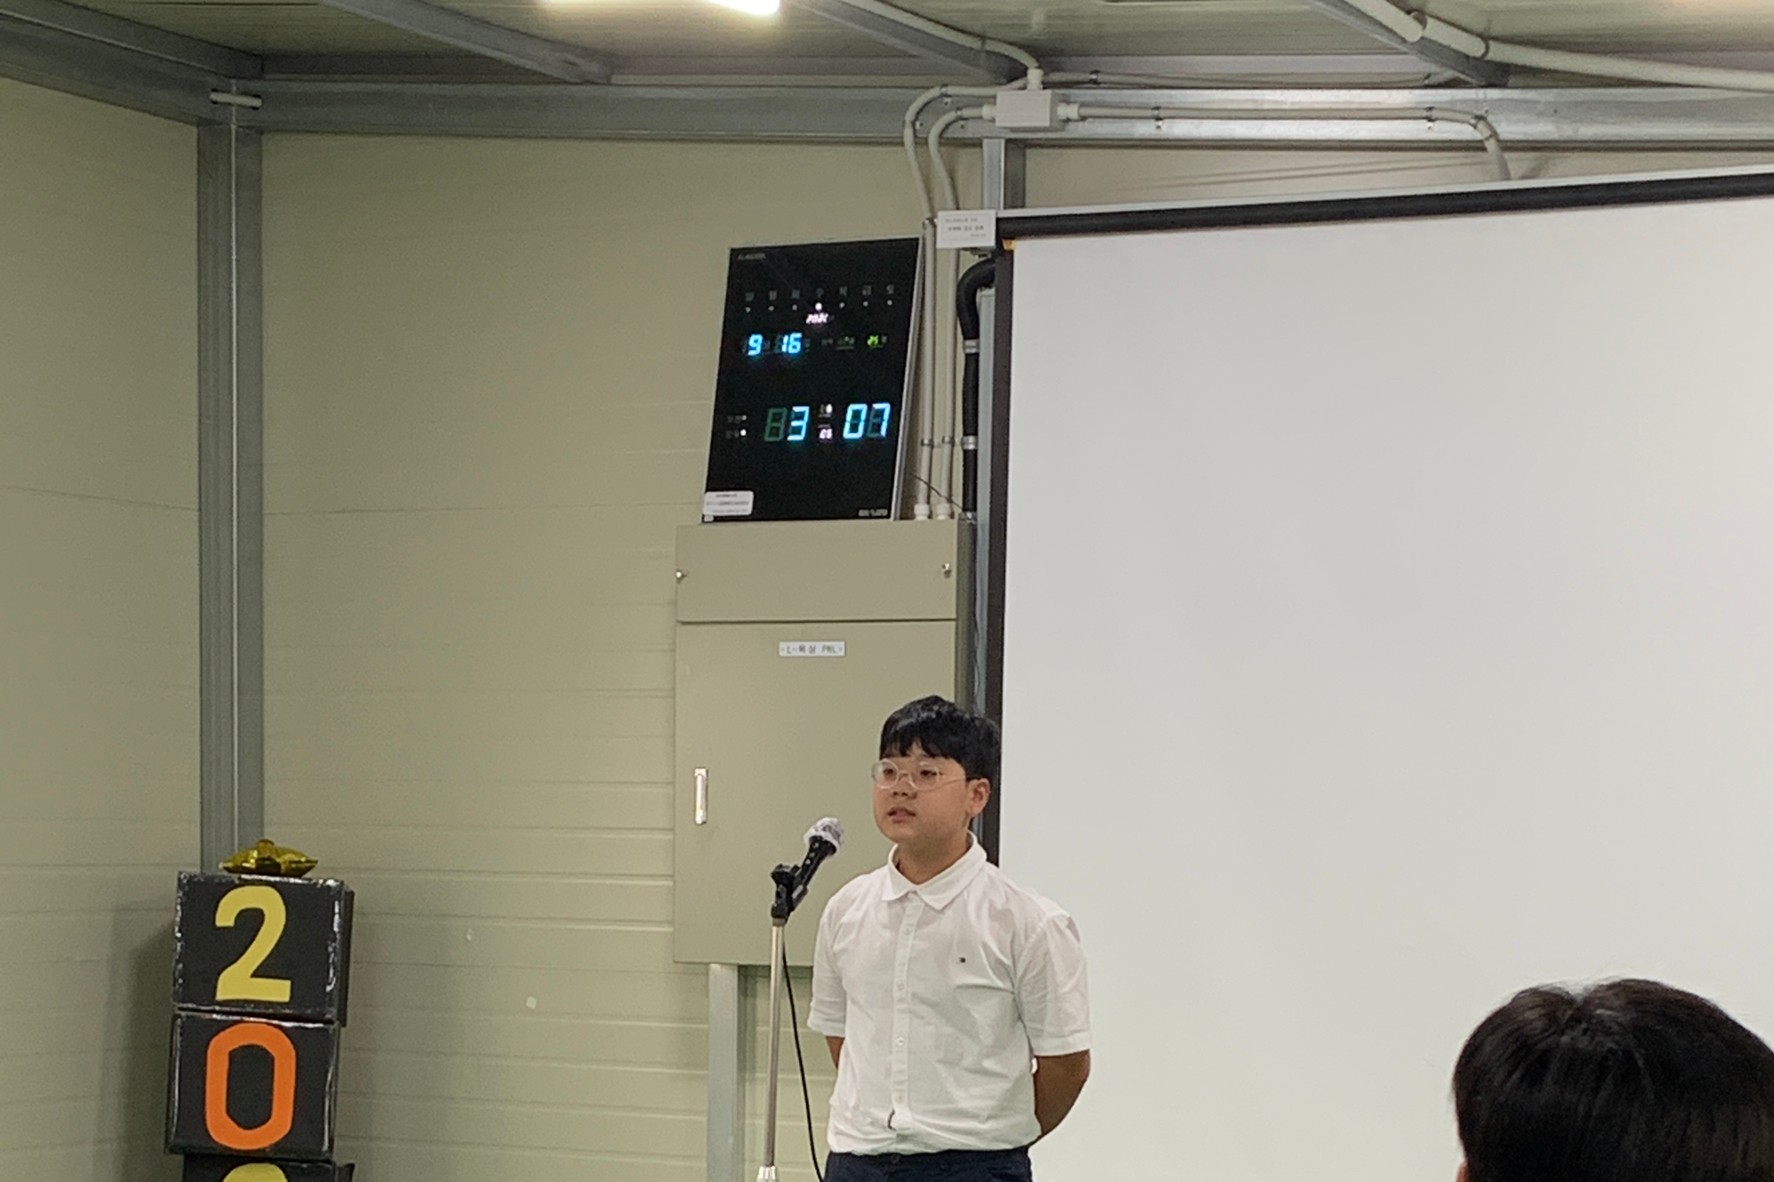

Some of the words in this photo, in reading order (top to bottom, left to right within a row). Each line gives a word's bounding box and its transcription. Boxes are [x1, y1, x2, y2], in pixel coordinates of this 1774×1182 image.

[748, 334, 763, 355] 9
[781, 332, 802, 354] 16
[842, 402, 891, 439] 07
